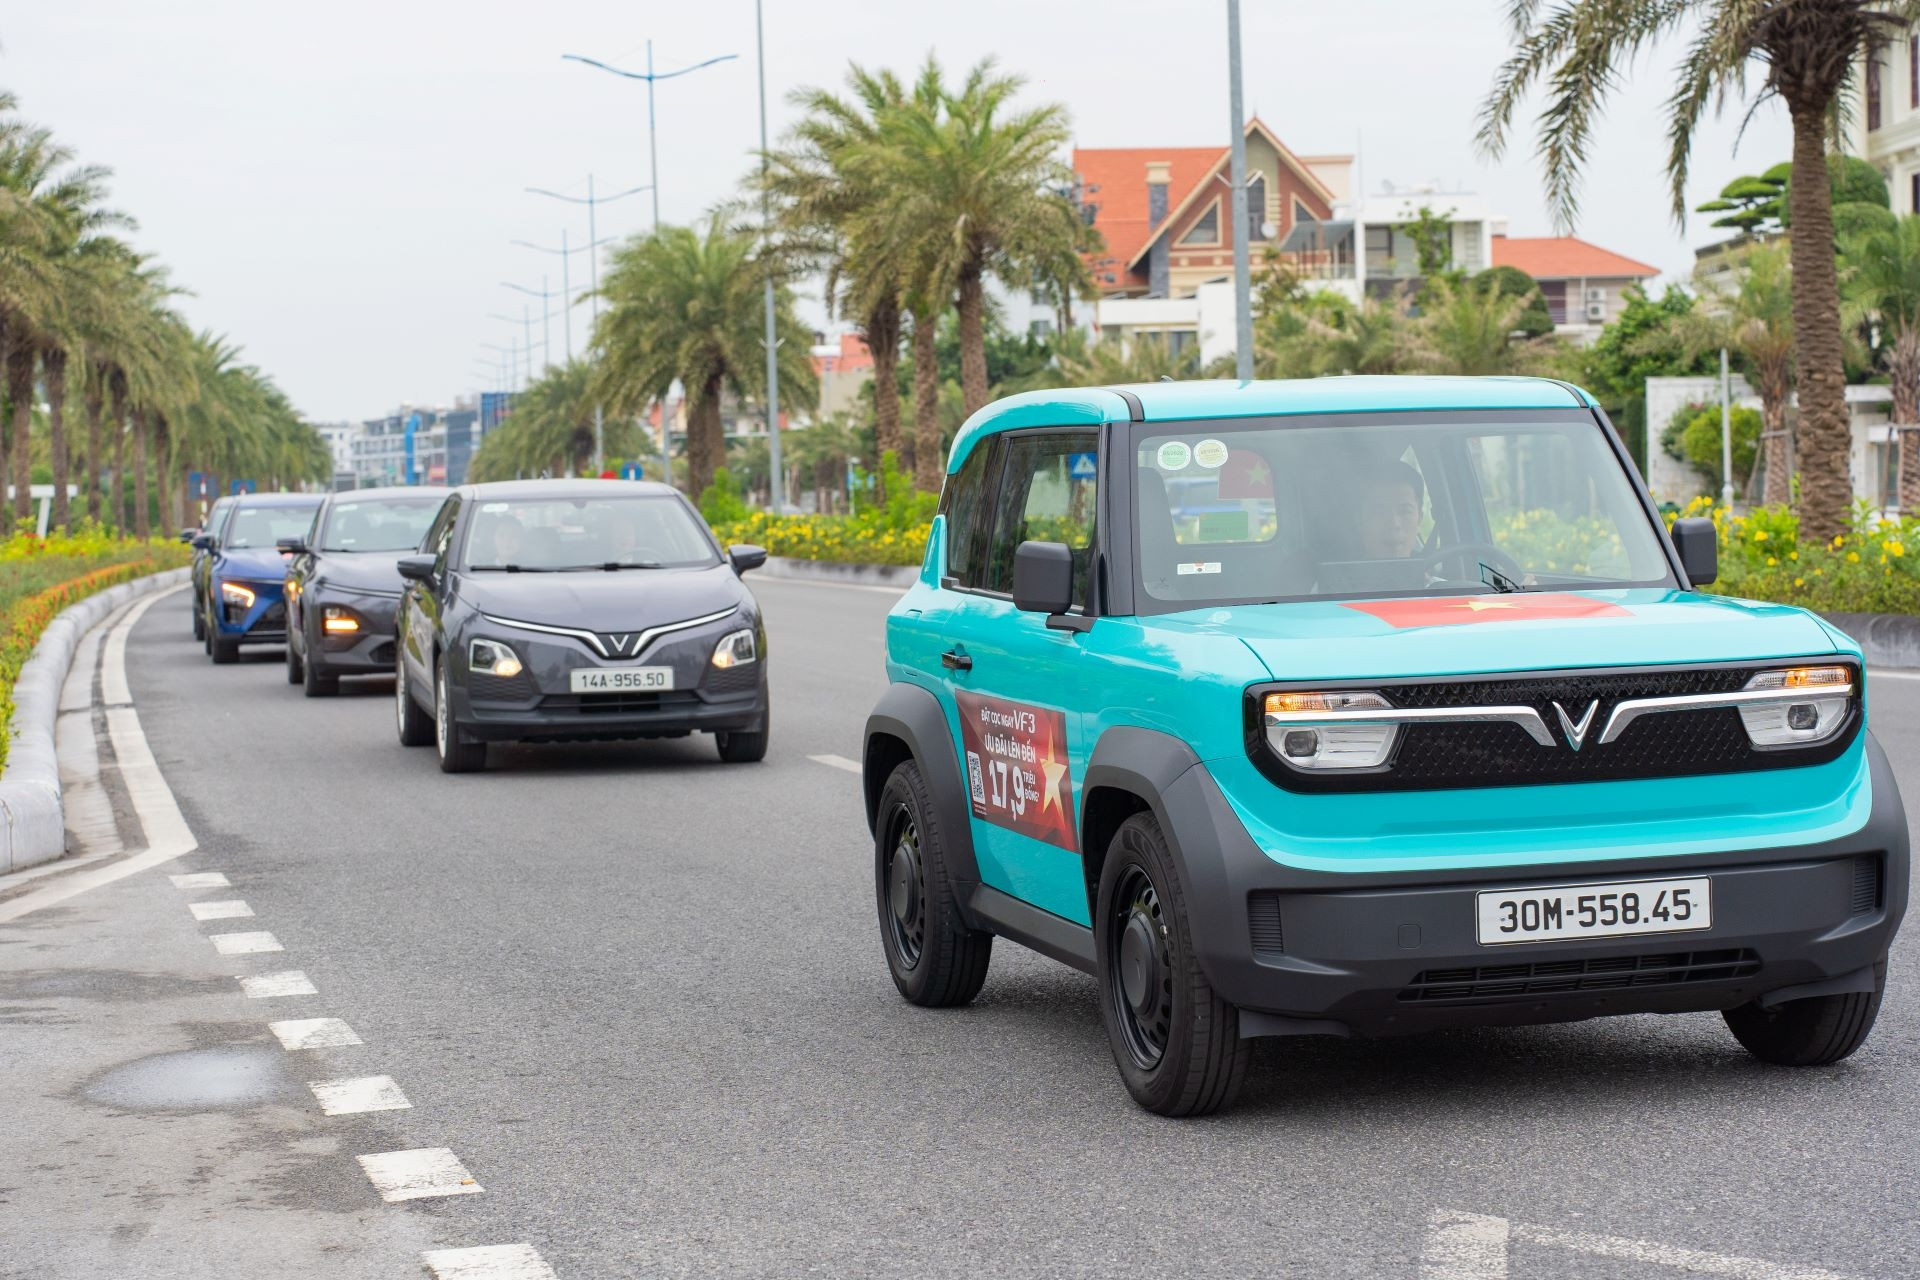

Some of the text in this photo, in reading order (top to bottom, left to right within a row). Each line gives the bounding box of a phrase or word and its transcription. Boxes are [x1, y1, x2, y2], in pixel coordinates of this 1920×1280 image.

[582, 673, 665, 688] 14A-956.50
[1000, 713, 1014, 729] NGAY
[995, 734, 1008, 756] ĐÃI
[1007, 736, 1021, 760] LÊN
[1022, 738, 1036, 764] ĐẾN
[988, 760, 1025, 821] 17,9
[1499, 888, 1691, 933] 30M-558.45
